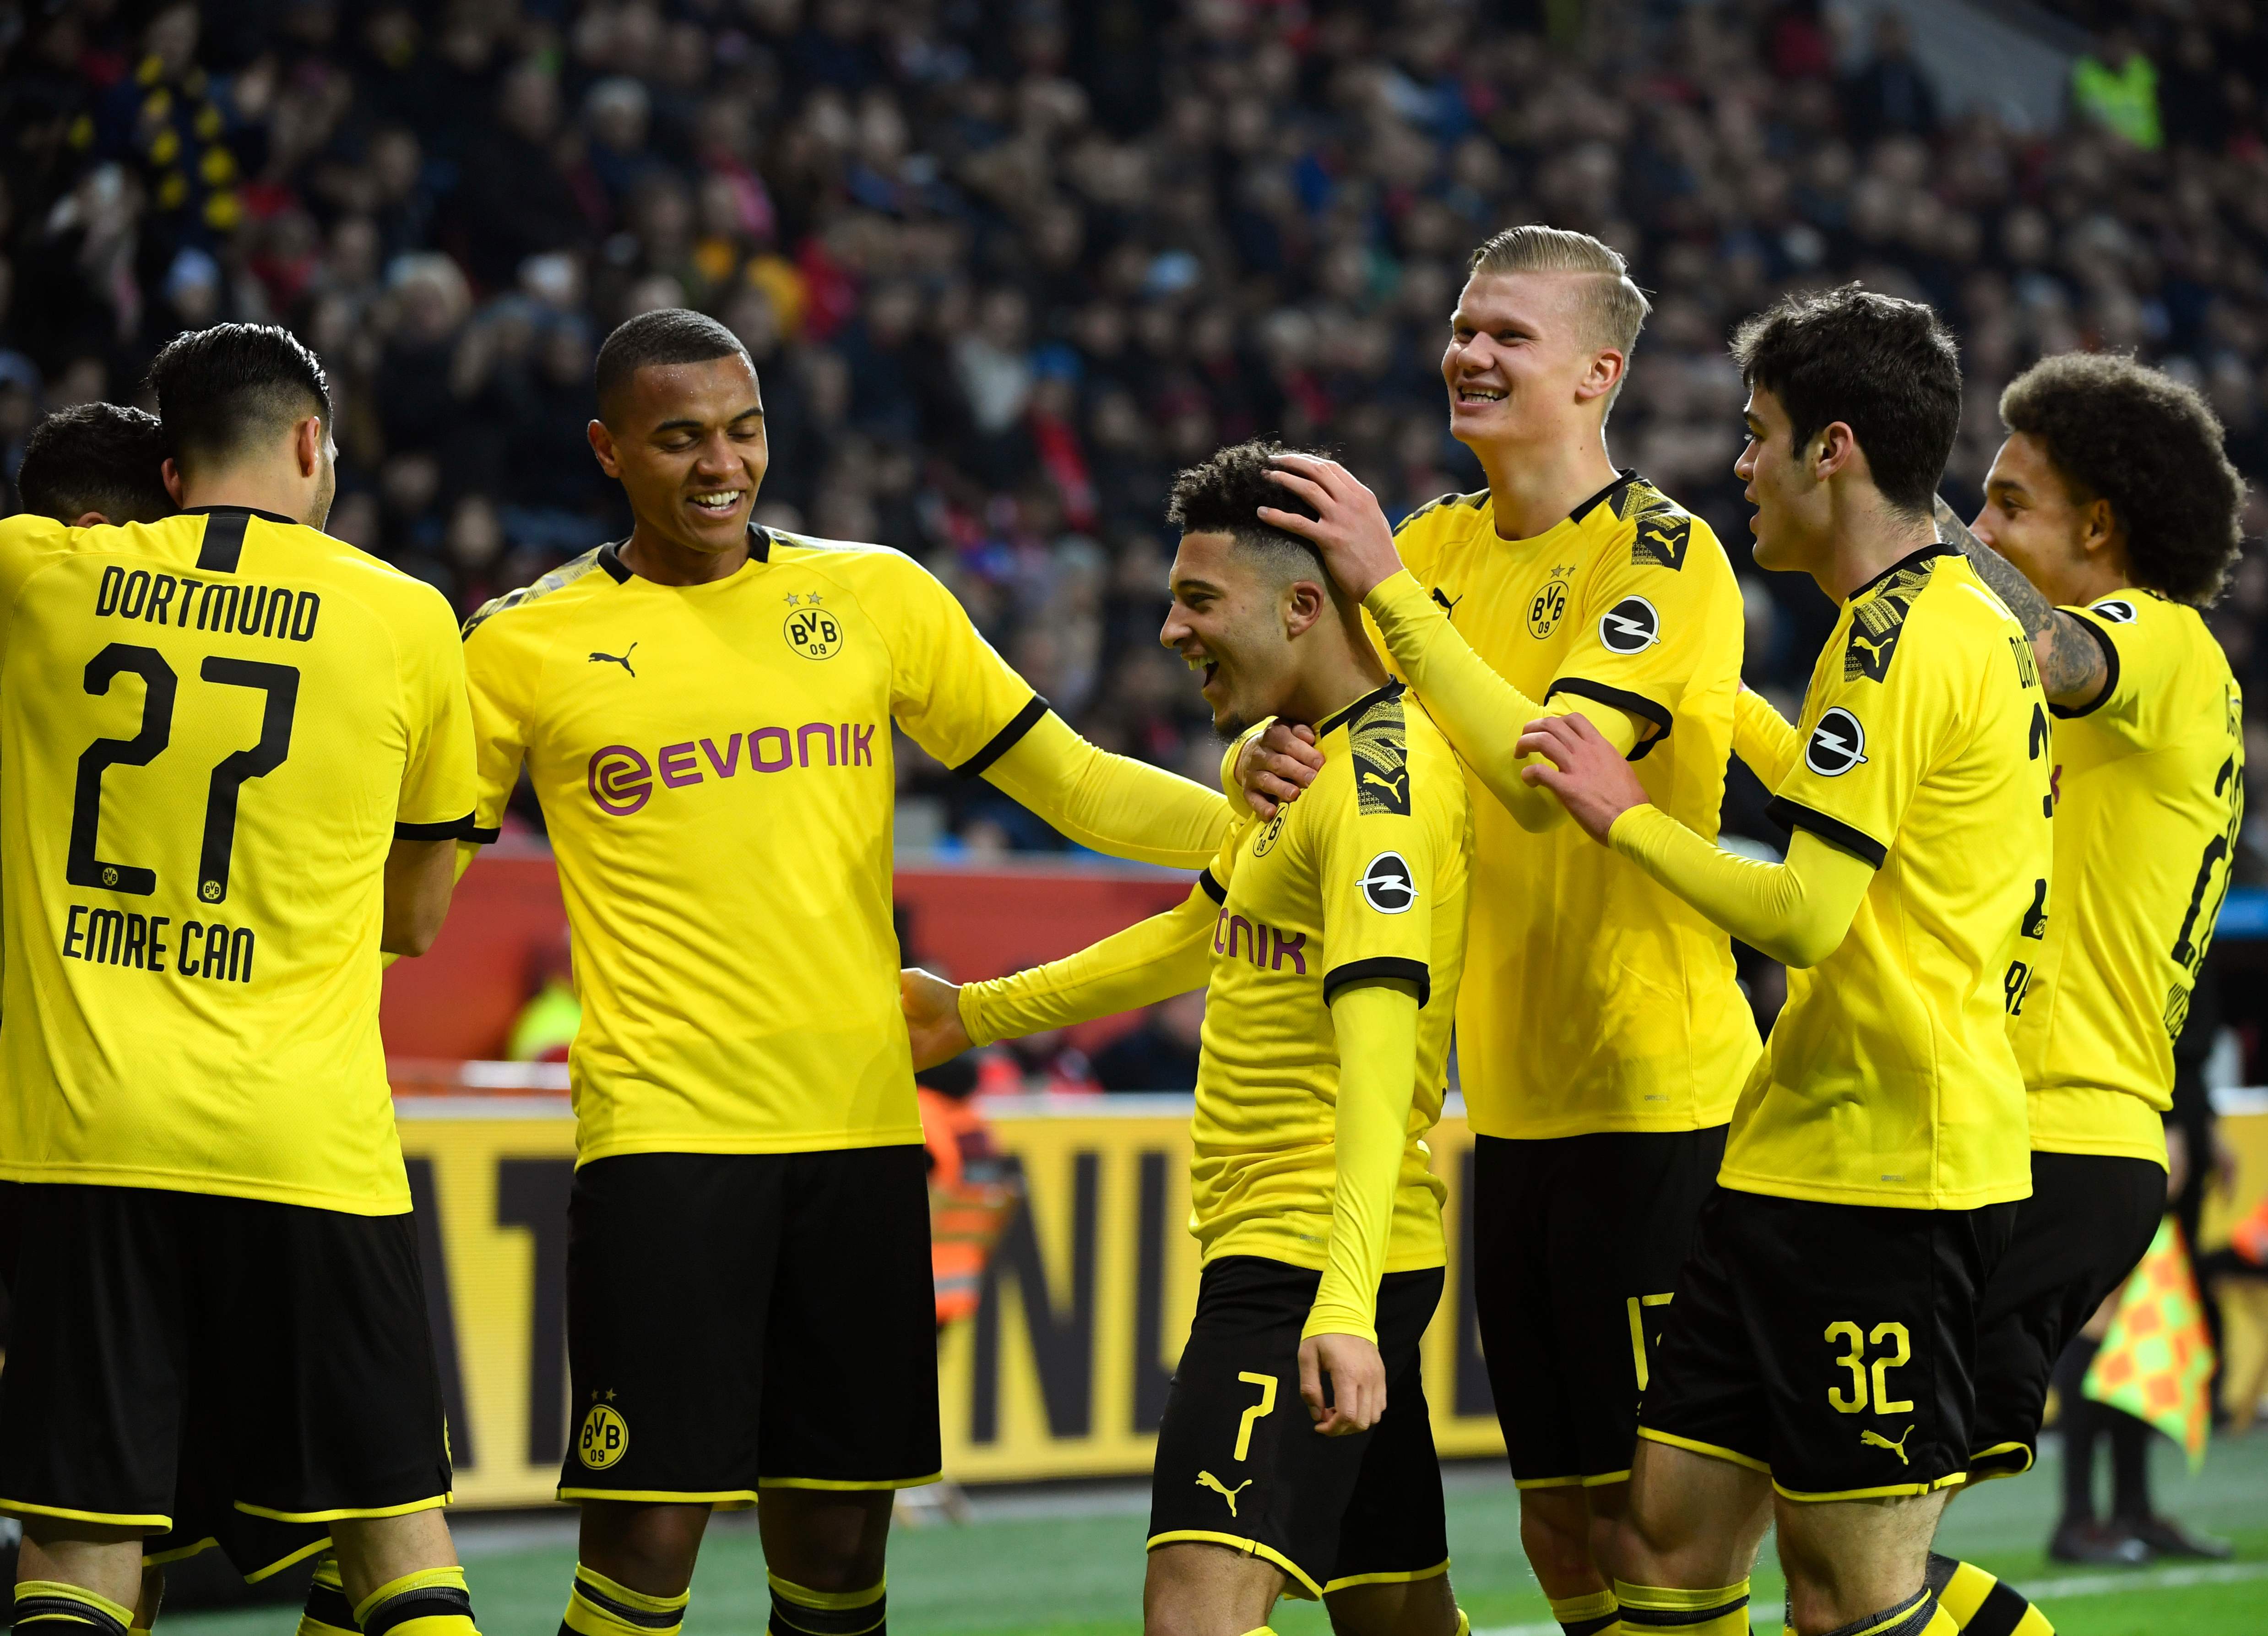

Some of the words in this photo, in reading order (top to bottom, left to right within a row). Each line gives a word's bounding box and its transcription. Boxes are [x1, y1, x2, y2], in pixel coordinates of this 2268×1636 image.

[96, 565, 320, 641] DORTMUND
[1532, 586, 1565, 621] BVB
[790, 612, 837, 645] BVB
[1538, 621, 1551, 634] 09
[809, 643, 827, 656] 09
[66, 642, 300, 904] 27
[658, 723, 875, 788] EVONIK
[1257, 839, 1266, 852] 09
[205, 882, 220, 895] BVB
[63, 905, 170, 971] EMRE
[177, 921, 255, 983] CAN
[1824, 1321, 1914, 1414] 32
[582, 1412, 620, 1450] BVB
[1233, 1371, 1278, 1461] 7
[591, 1450, 605, 1462] 09
